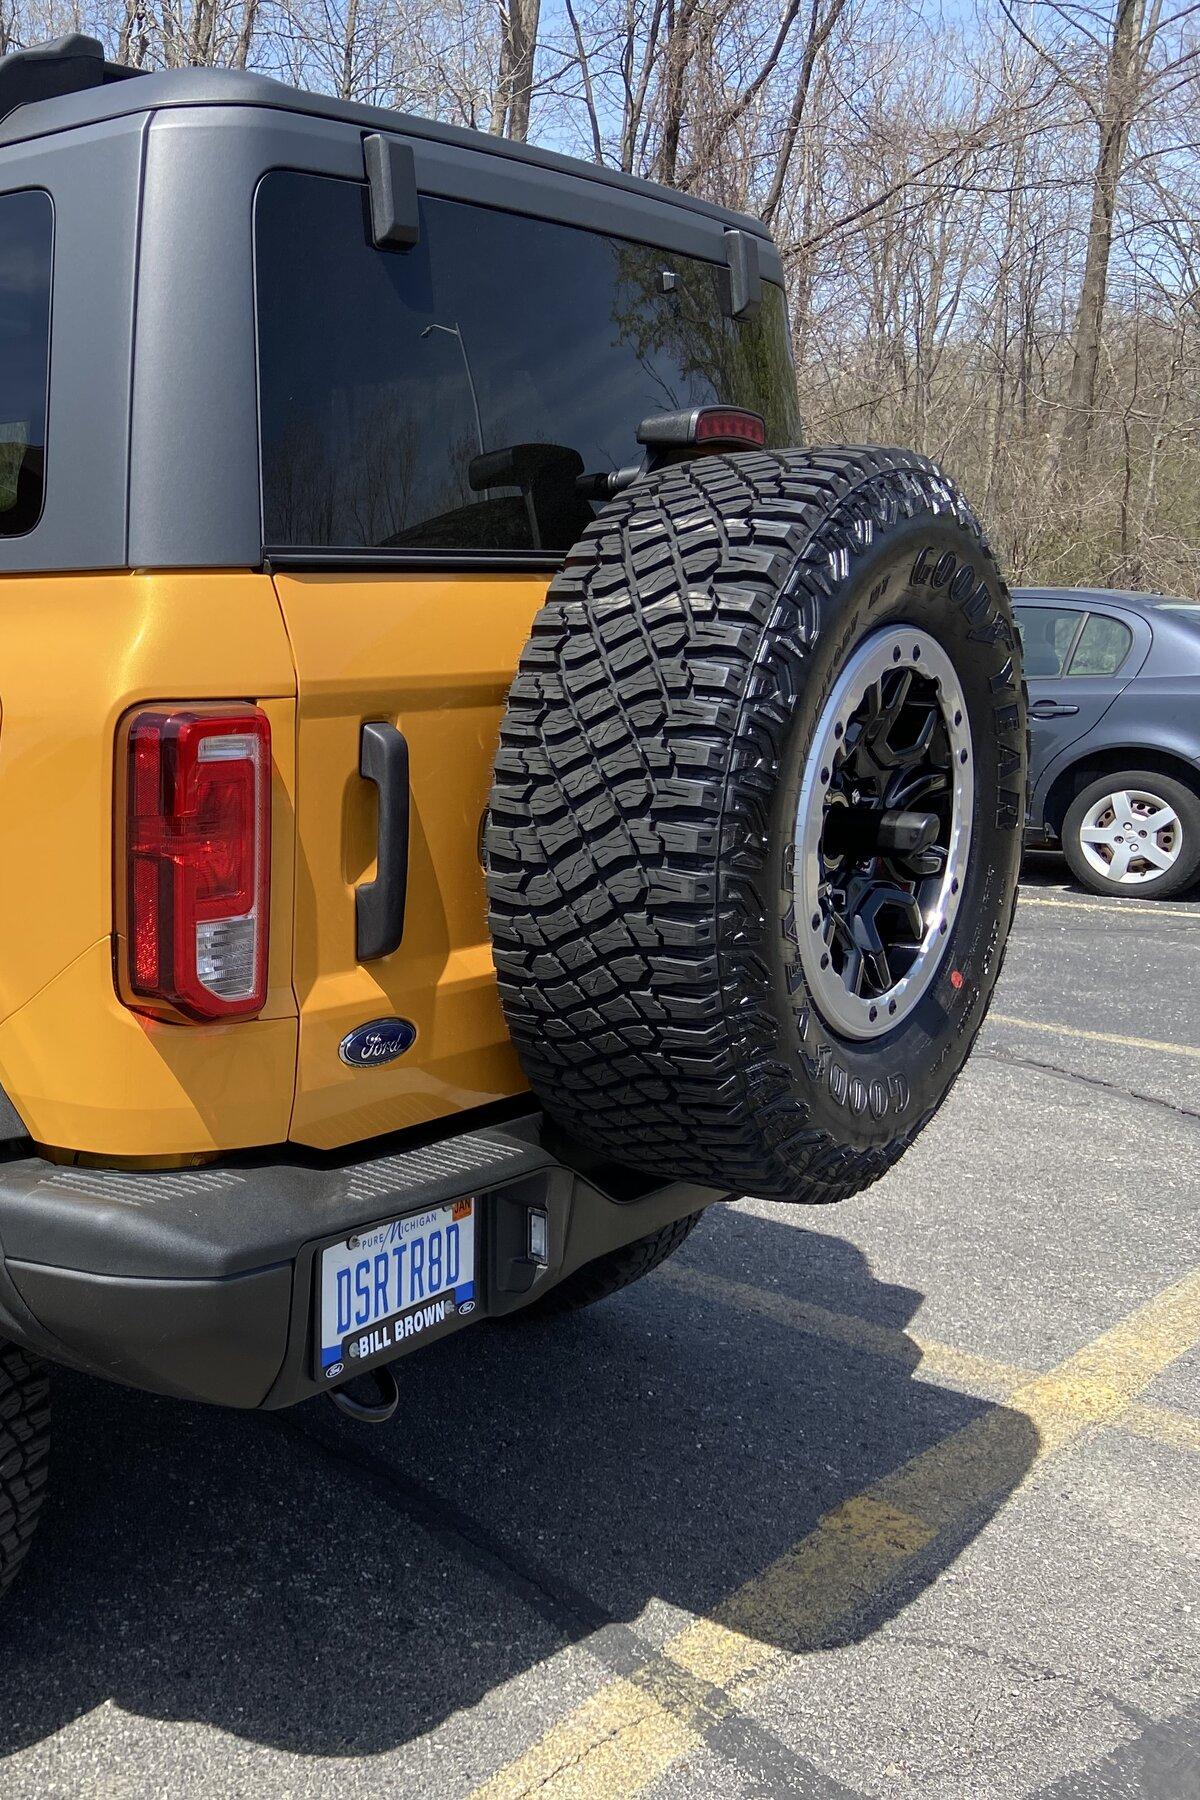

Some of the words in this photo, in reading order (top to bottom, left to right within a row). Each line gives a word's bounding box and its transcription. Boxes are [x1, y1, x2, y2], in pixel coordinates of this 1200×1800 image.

[910, 547, 1021, 830] GOODYEAR
[361, 1032, 402, 1059] Ford
[454, 1198, 472, 1214] JAN
[362, 1233, 385, 1251] PURE
[381, 1212, 437, 1252] MICHIGAN
[337, 1223, 460, 1335] DSRTR8D
[358, 1327, 391, 1359] BILL
[394, 1300, 446, 1342] BROWN
